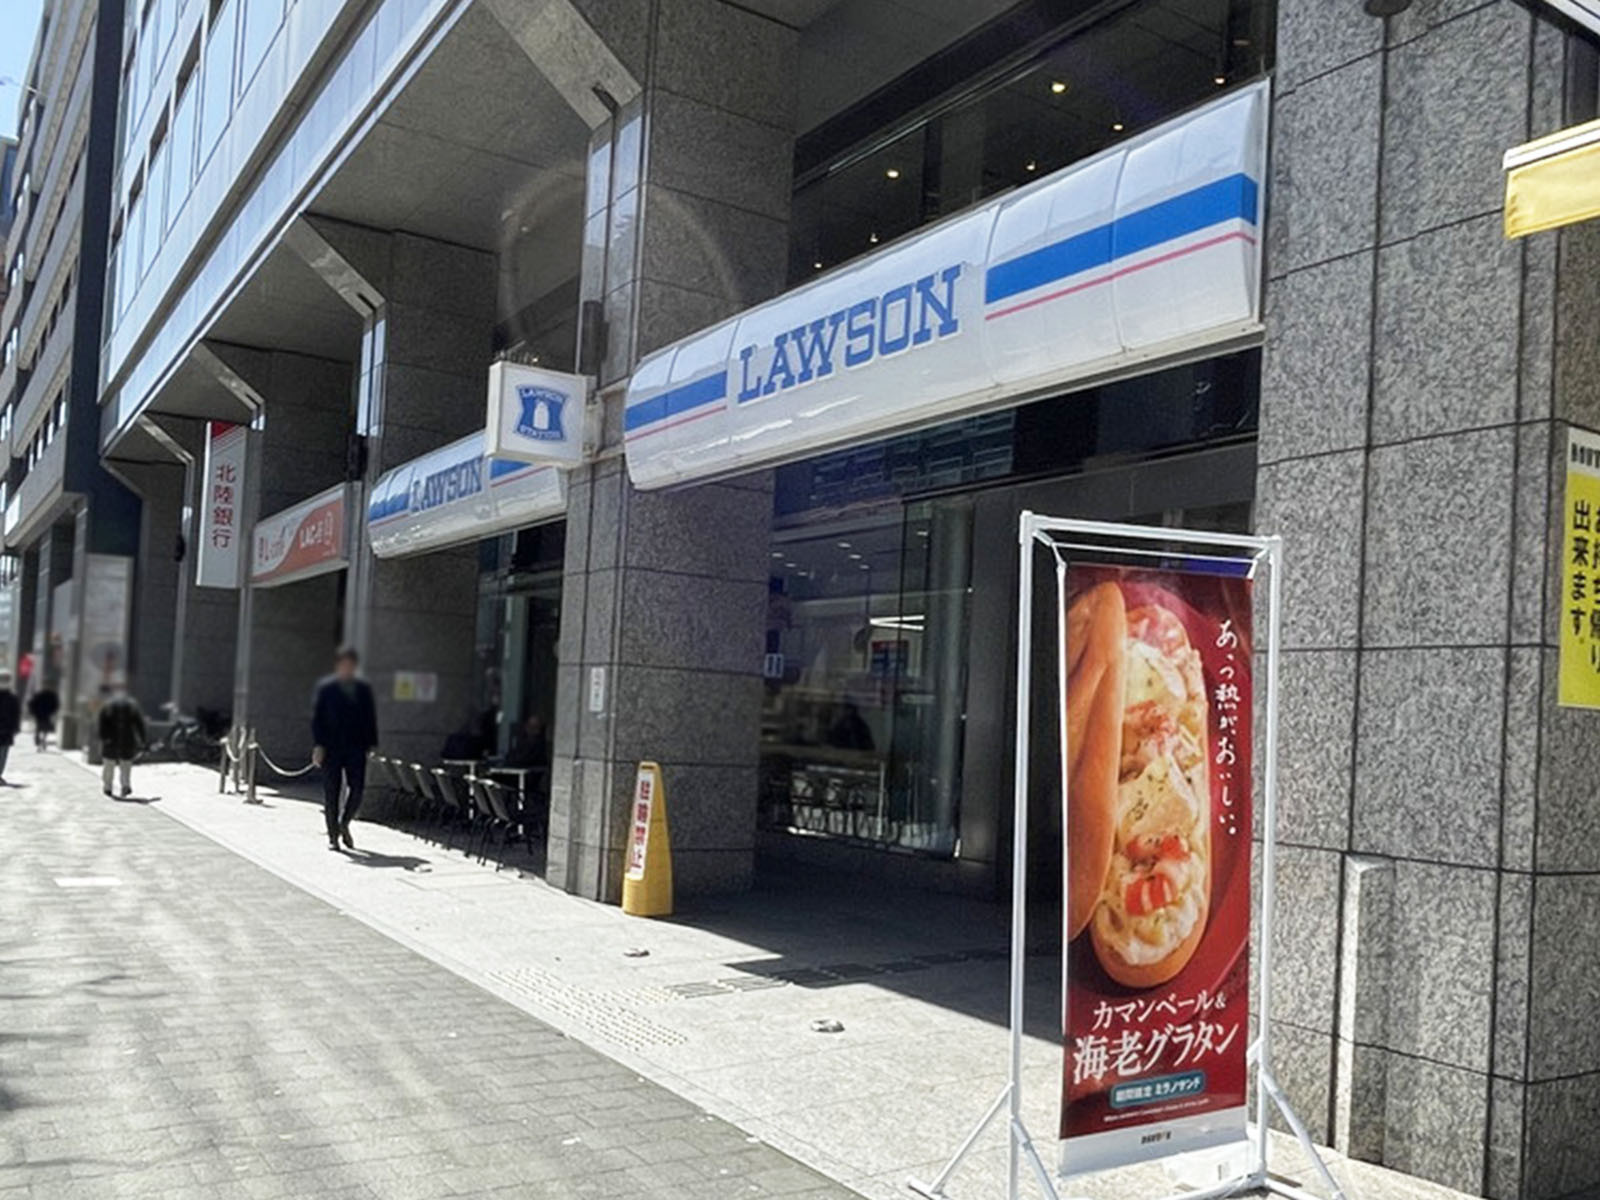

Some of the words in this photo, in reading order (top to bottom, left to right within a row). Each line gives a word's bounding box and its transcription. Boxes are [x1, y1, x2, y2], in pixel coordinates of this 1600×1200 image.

[738, 264, 961, 404] LAWSON
[212, 464, 236, 549] 北陸銀行
[410, 454, 485, 513] LAWSON
[1072, 1021, 1240, 1085] 海老グラタン
